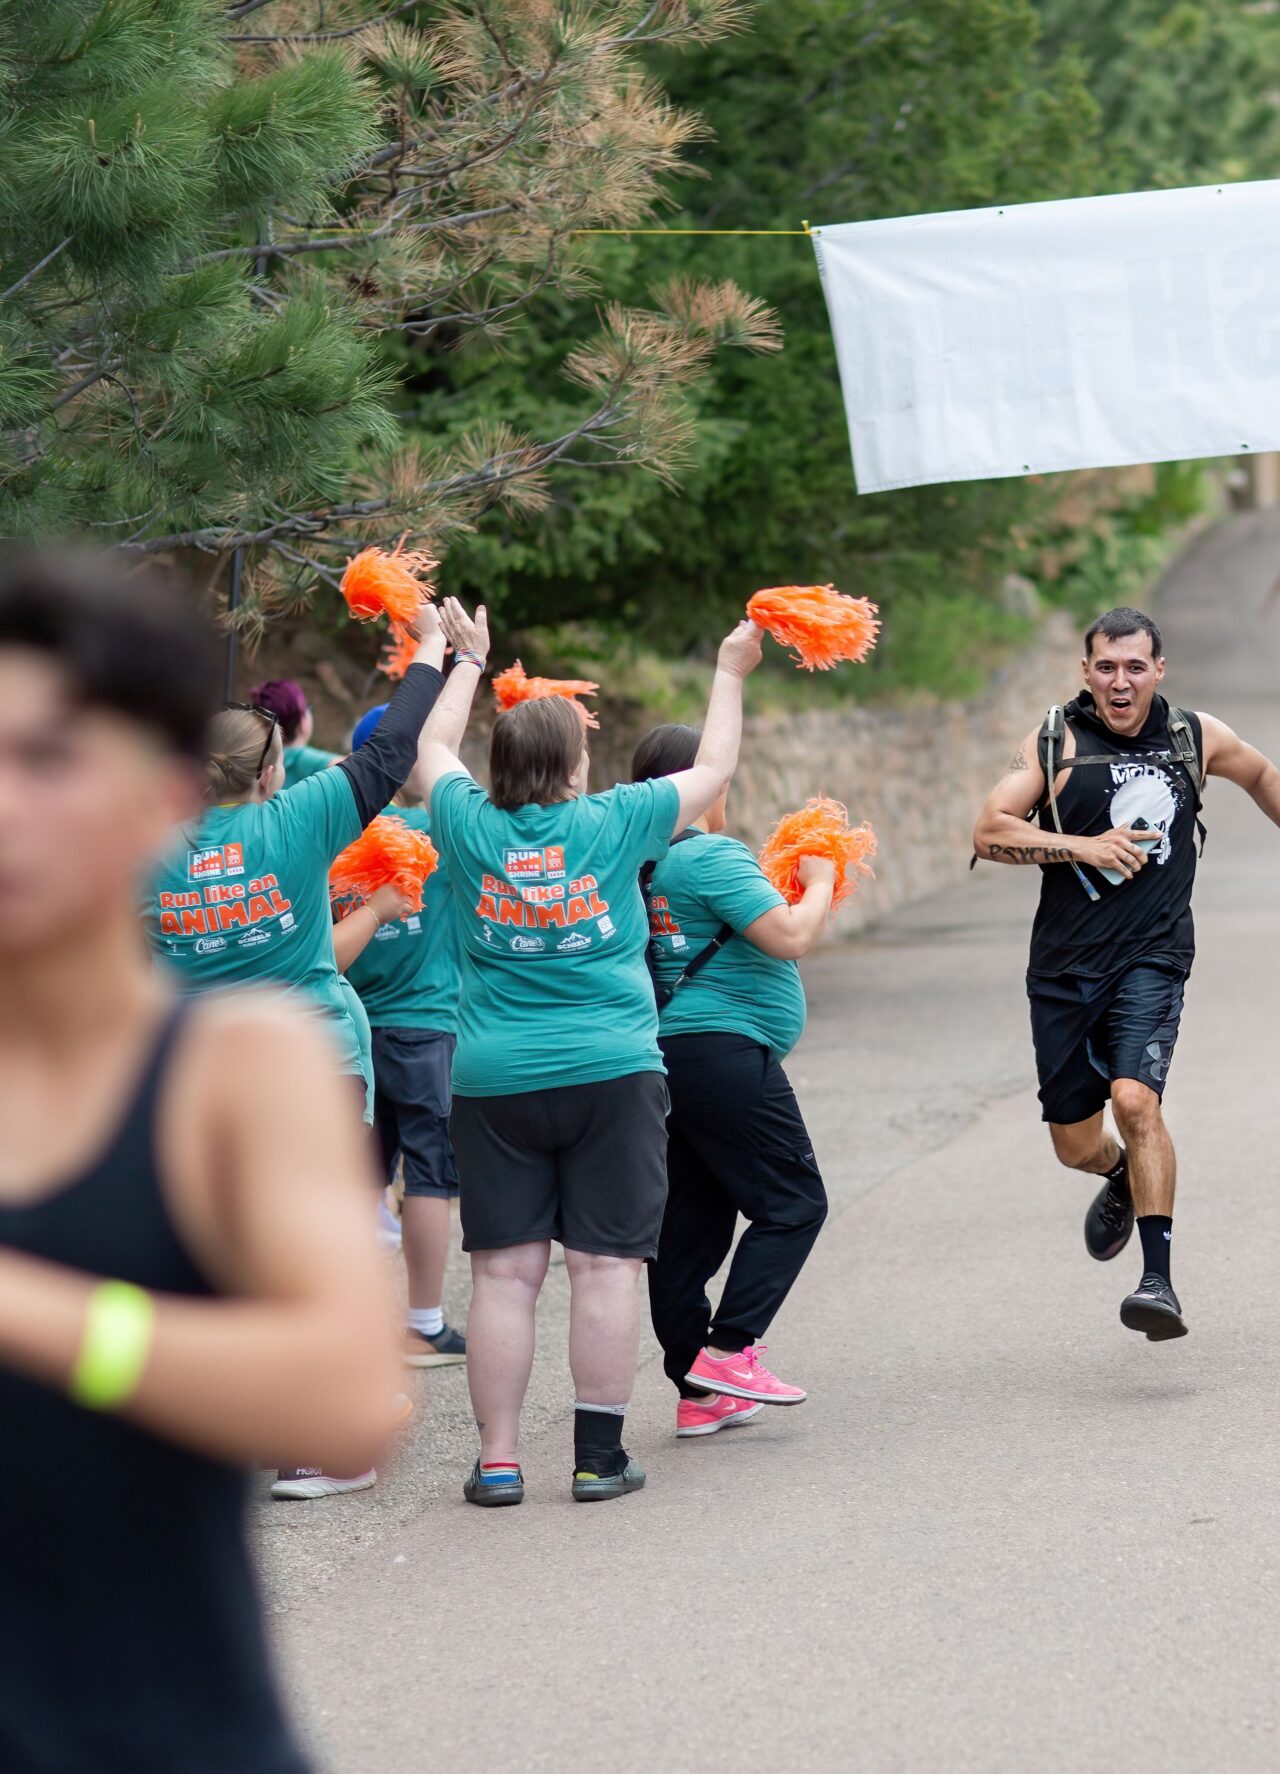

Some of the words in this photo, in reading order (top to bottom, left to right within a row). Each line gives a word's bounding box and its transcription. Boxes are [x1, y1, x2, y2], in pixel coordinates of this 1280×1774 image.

[193, 849, 219, 867] RUN
[507, 851, 539, 865] RUN
[989, 843, 1073, 865] PSYCHO
[508, 870, 541, 879] SHRINE
[160, 890, 201, 909] Run
[204, 883, 246, 904] like
[248, 873, 279, 894] an
[481, 873, 519, 898] Run
[521, 884, 565, 903] like
[569, 874, 598, 895] an
[160, 889, 292, 936] ANIMAL
[475, 890, 610, 929] ANIMAL
[281, 924, 299, 936] TOYOTA
[237, 931, 272, 945] SCHEELS
[556, 937, 592, 949] SCHEELS
[673, 945, 691, 954] TOYOTA
[296, 1466, 322, 1476] HOKA
